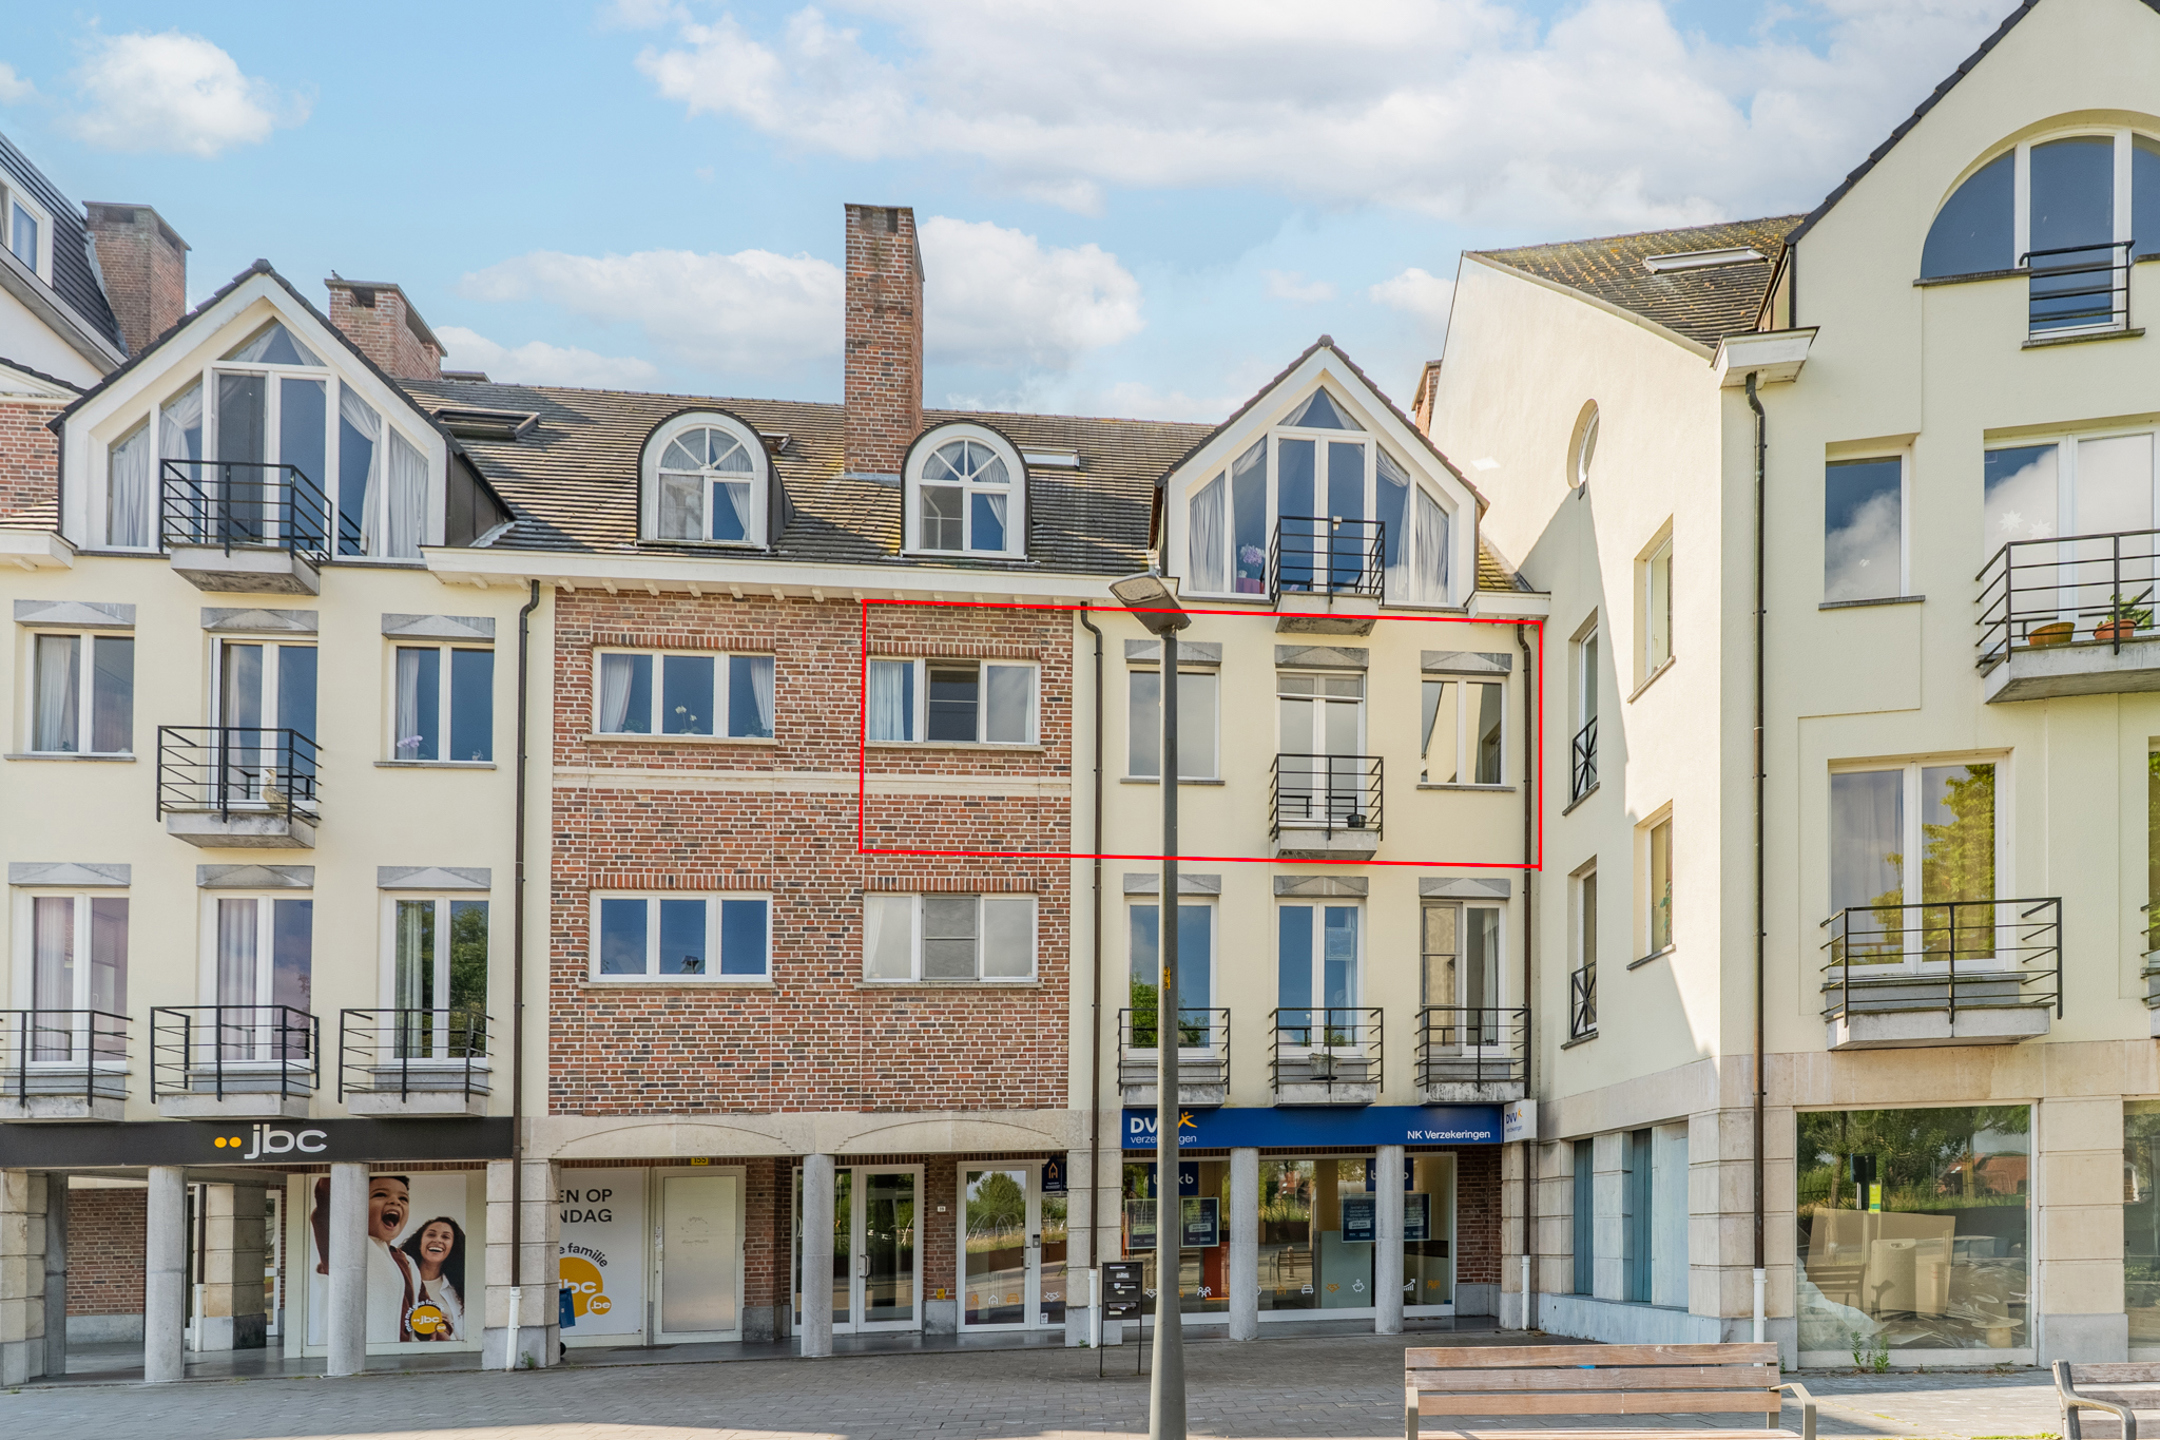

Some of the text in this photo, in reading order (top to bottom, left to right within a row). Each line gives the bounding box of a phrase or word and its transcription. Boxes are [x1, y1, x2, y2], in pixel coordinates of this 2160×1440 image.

[1130, 1117, 1158, 1134] DV
[243, 1123, 328, 1160] jbc
[1130, 1135, 1197, 1145] verzegen
[1407, 1130, 1491, 1141] NK Verzekeringen
[585, 1188, 613, 1203] OP
[567, 1242, 608, 1268] familie
[419, 1315, 440, 1325] jbc
